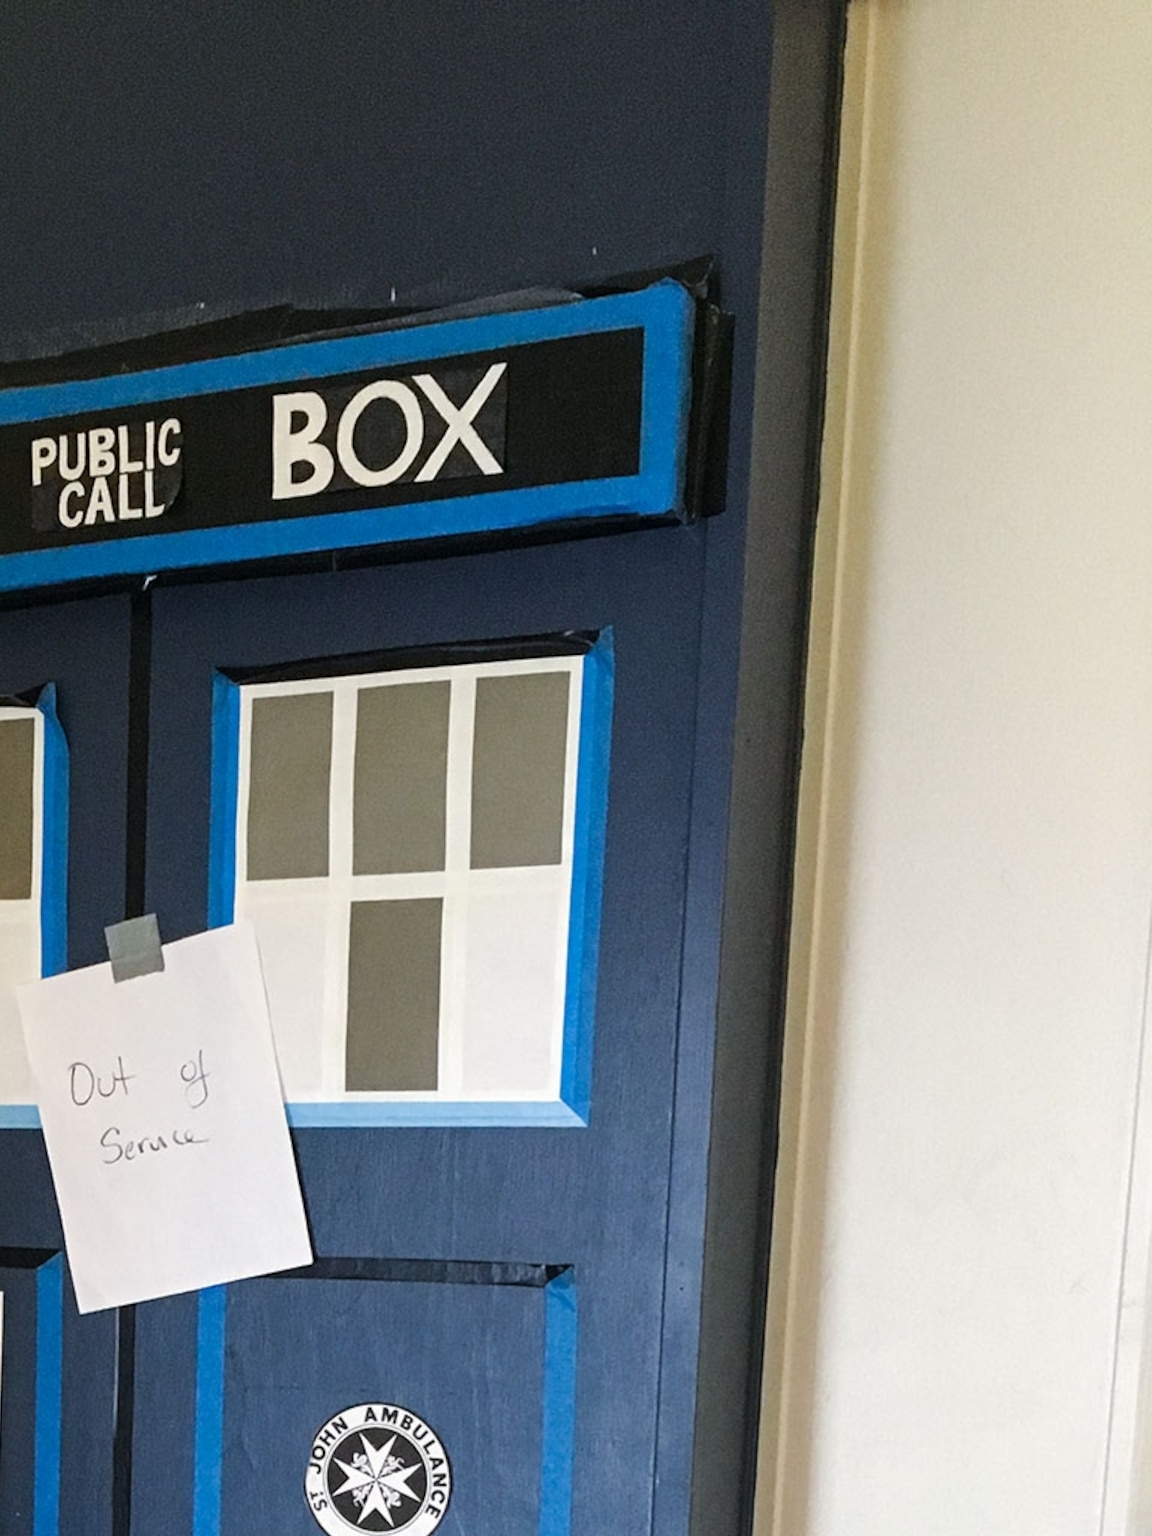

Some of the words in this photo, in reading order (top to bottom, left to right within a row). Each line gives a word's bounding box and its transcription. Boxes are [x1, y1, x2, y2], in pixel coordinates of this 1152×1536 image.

[31, 417, 182, 486] PUBLIC
[271, 362, 507, 501] BOX
[58, 471, 166, 528] CALL
[67, 1056, 135, 1106] Out
[180, 1050, 211, 1109] of
[309, 1417, 348, 1474] JOHN
[364, 1407, 447, 1519] AMBULANCE
